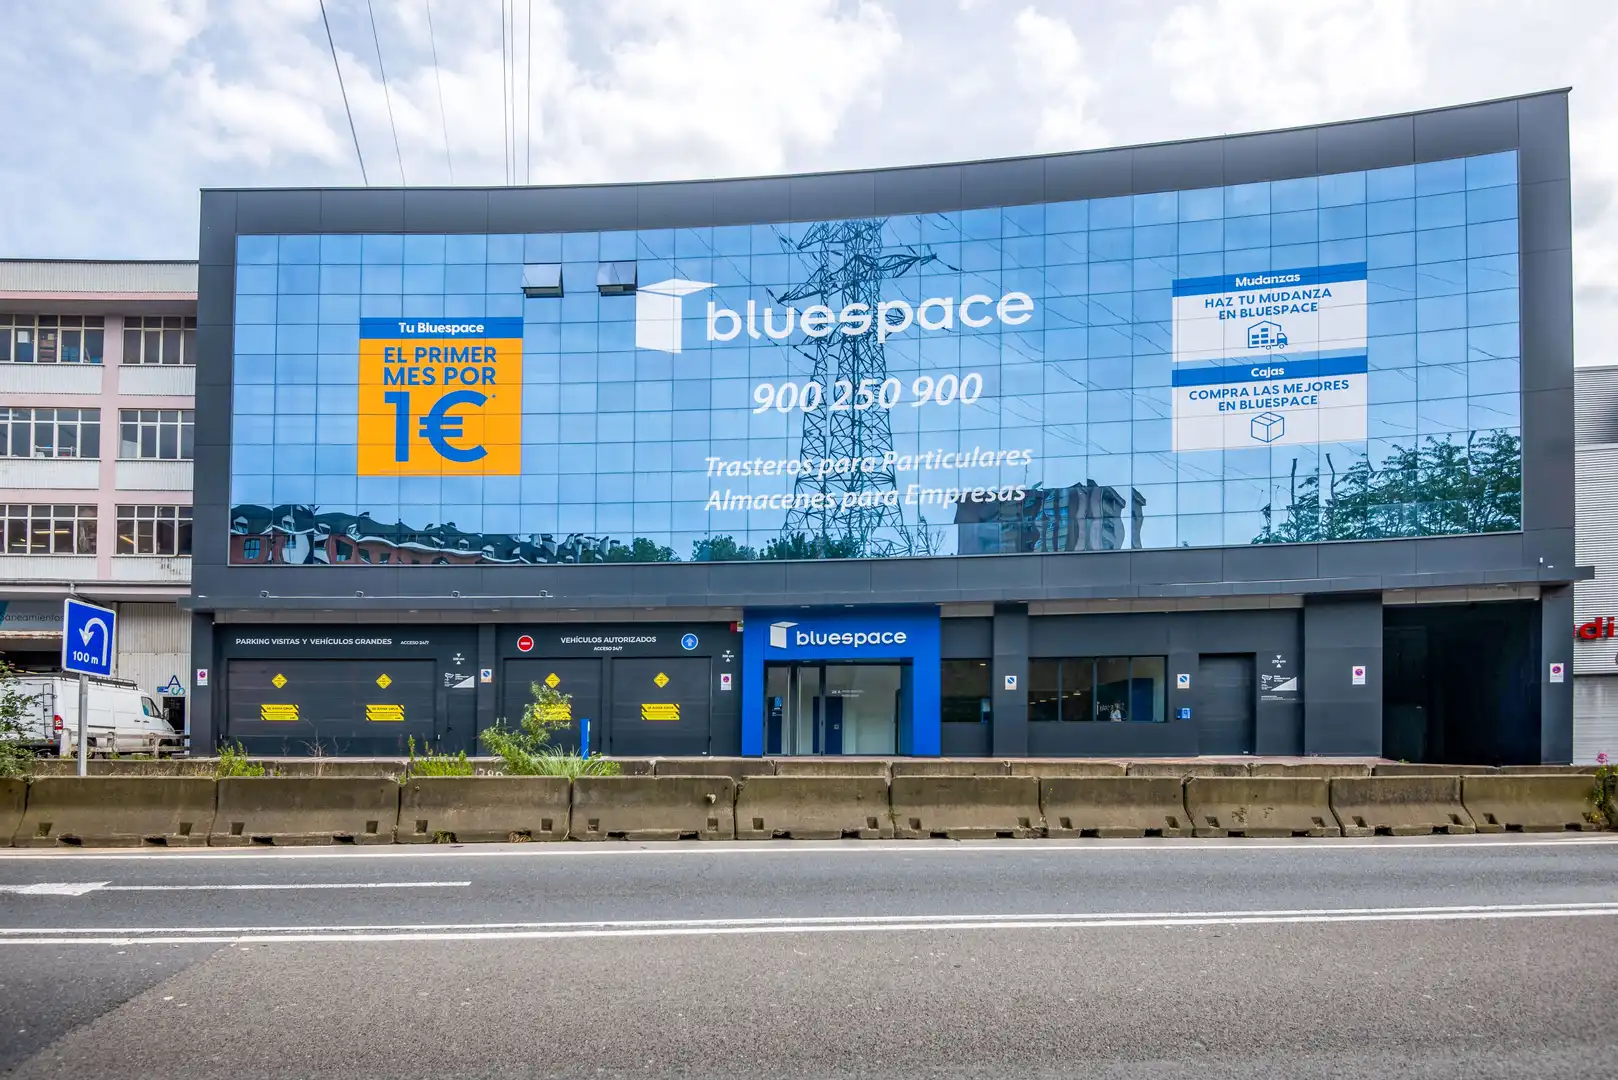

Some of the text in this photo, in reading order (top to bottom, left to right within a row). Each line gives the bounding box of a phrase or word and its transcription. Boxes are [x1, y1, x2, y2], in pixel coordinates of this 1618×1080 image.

[1235, 272, 1301, 287] Mudanzas
[1205, 288, 1332, 308] HAZ TU MUDANZA
[707, 291, 1034, 344] bluespace
[1219, 302, 1318, 320] EN BLUESPACE
[399, 322, 484, 335] Tu Bluespace
[384, 346, 497, 363] EL PRIMER
[383, 366, 496, 385] MES POR
[1250, 366, 1285, 378] Cajas
[752, 372, 983, 414] 900 250 900
[1189, 379, 1349, 400] COMPRA LAS MEJORES
[1218, 395, 1317, 411] EN BLUESPACE
[704, 446, 1033, 481] Trasteros para Particulares
[704, 482, 1027, 513] Almacenes para Empresas
[1573, 616, 1615, 640] di
[310, 637, 354, 645] VEHÍCULOS
[560, 635, 602, 644] VEHÍCULOS
[796, 631, 907, 647] bluespace
[73, 650, 99, 665] 100 m
